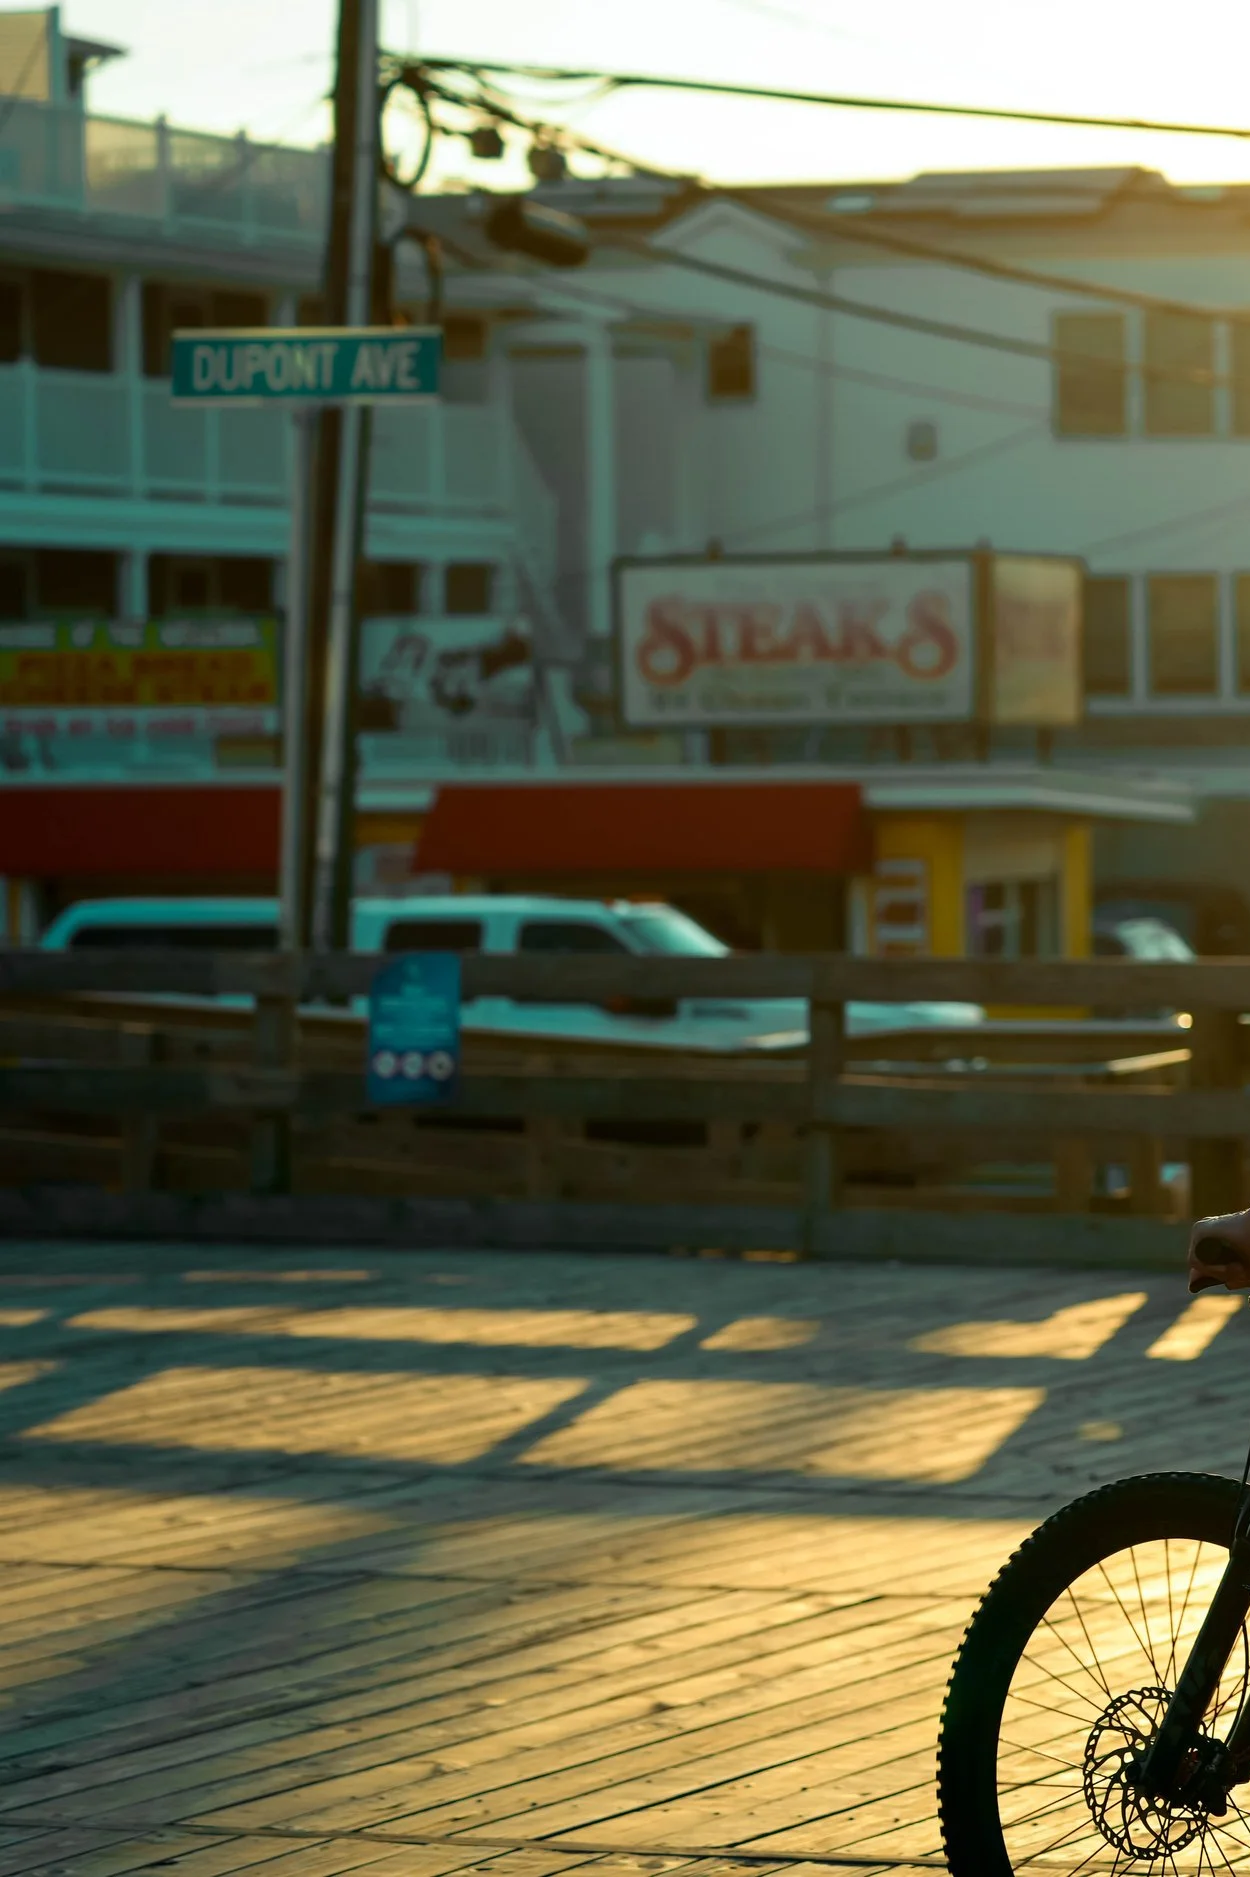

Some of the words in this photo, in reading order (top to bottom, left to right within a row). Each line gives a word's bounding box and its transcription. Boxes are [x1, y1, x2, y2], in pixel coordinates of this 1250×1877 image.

[193, 343, 338, 391] DUPONT
[352, 341, 421, 389] AVE
[635, 588, 960, 687] STEAKS
